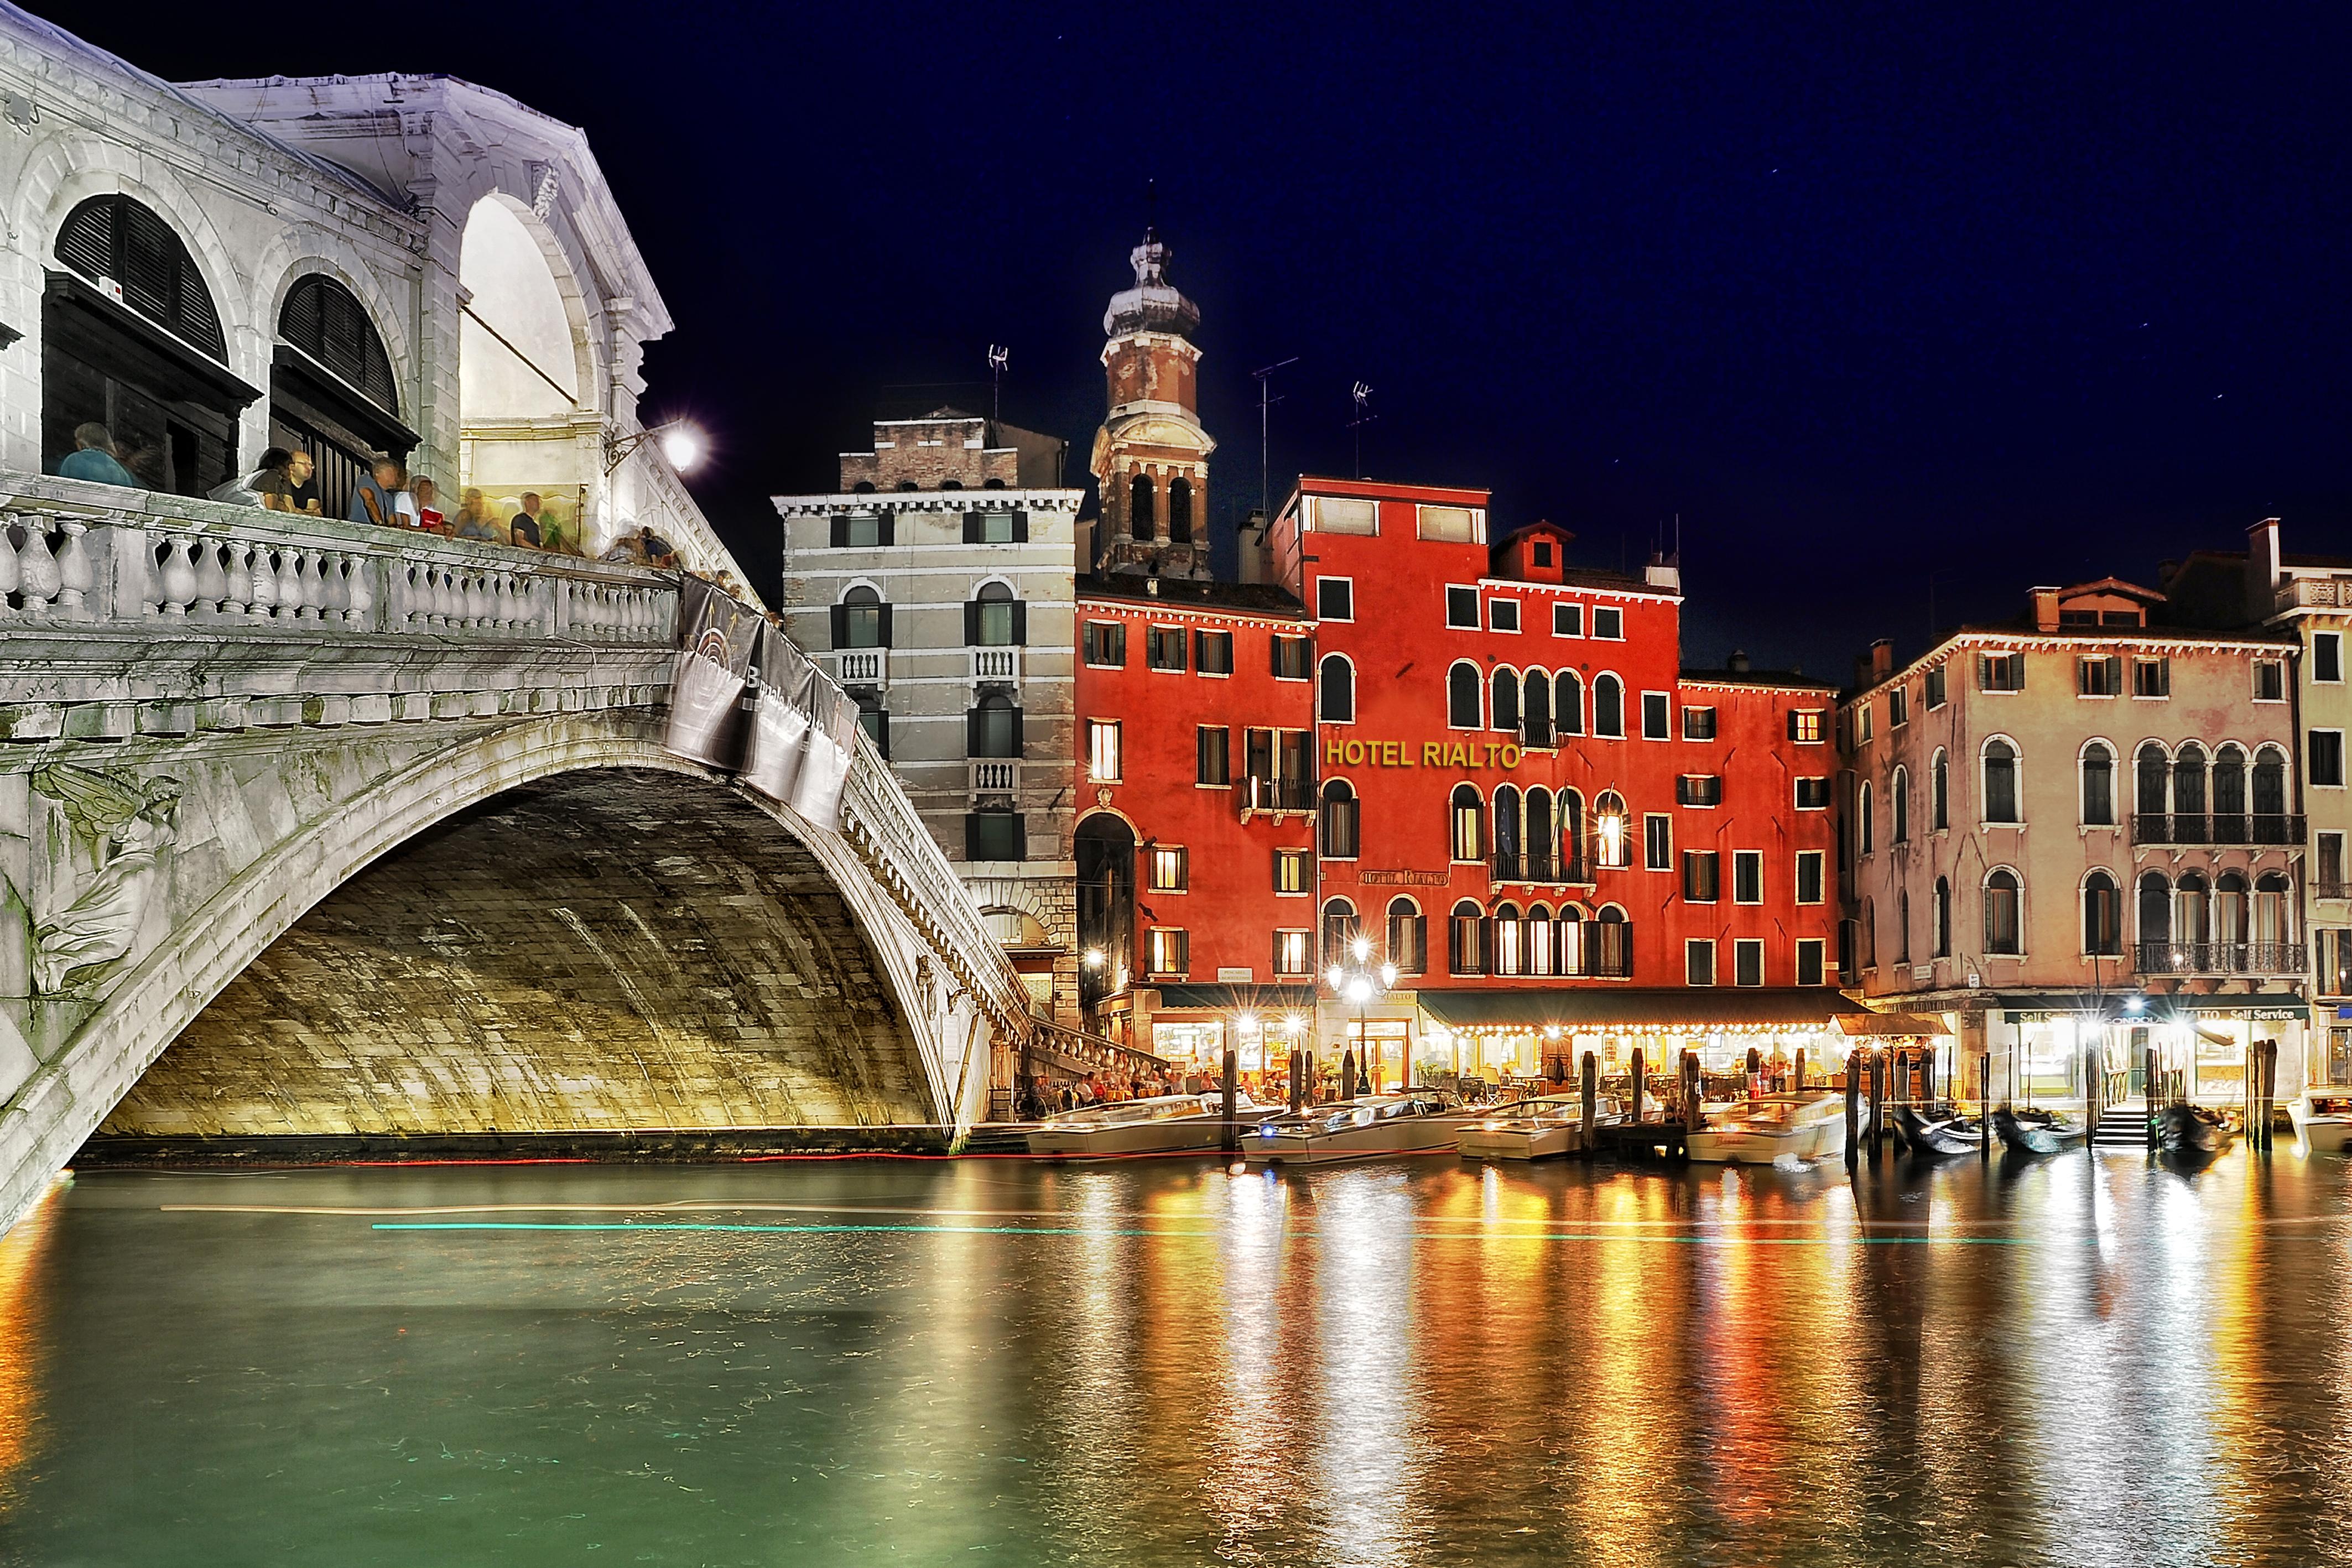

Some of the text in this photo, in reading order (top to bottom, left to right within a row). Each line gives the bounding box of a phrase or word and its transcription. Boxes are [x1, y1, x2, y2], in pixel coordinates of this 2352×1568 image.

[1326, 739, 1521, 768] HOTEL RIALTO
[1365, 869, 1448, 885] HOTEL RIALTO
[2020, 1012, 2042, 1023] Self
[2230, 1010, 2252, 1020] Self
[2254, 1009, 2294, 1019] Service
